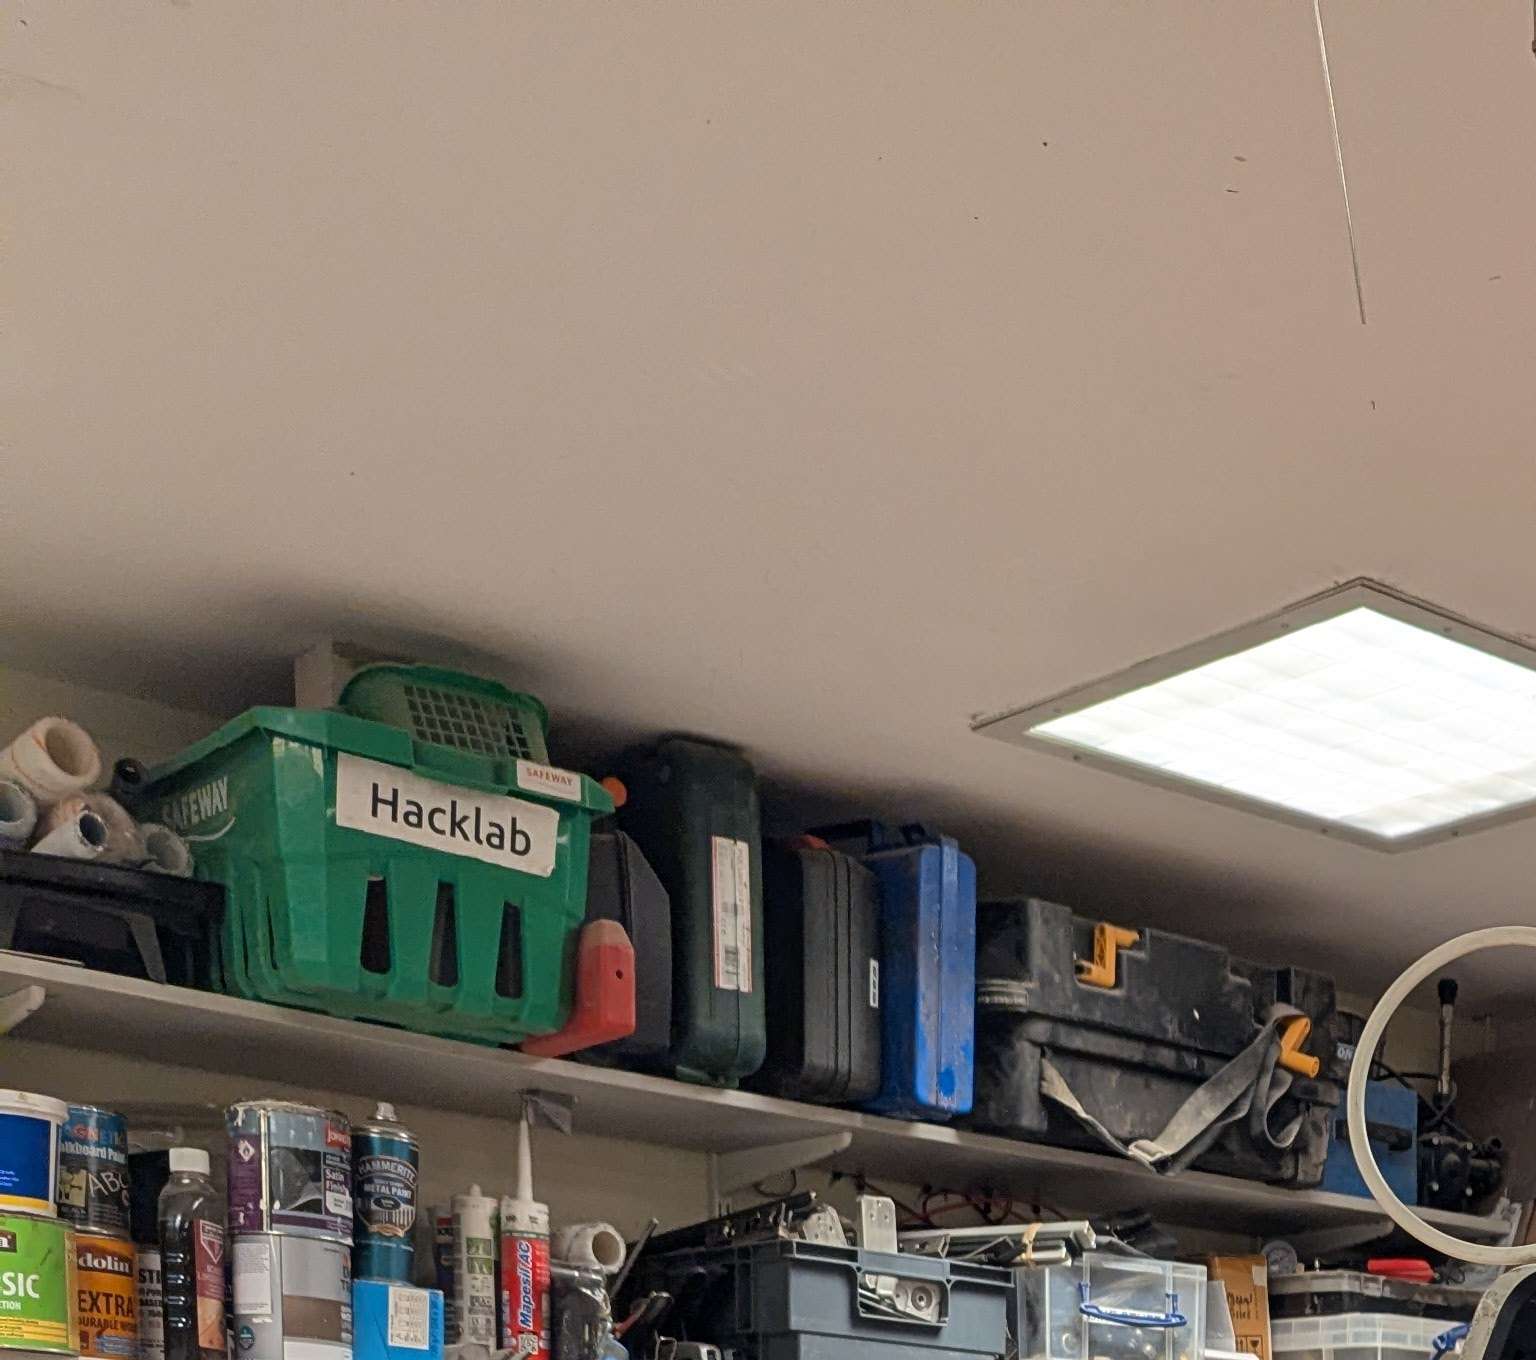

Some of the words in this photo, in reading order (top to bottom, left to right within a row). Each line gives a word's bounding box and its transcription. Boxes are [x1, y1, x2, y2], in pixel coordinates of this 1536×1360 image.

[526, 767, 573, 787] SAFEWAY
[371, 783, 532, 857] Hacklab
[325, 1168, 345, 1182] Satin
[78, 1290, 134, 1318] EXTRA
